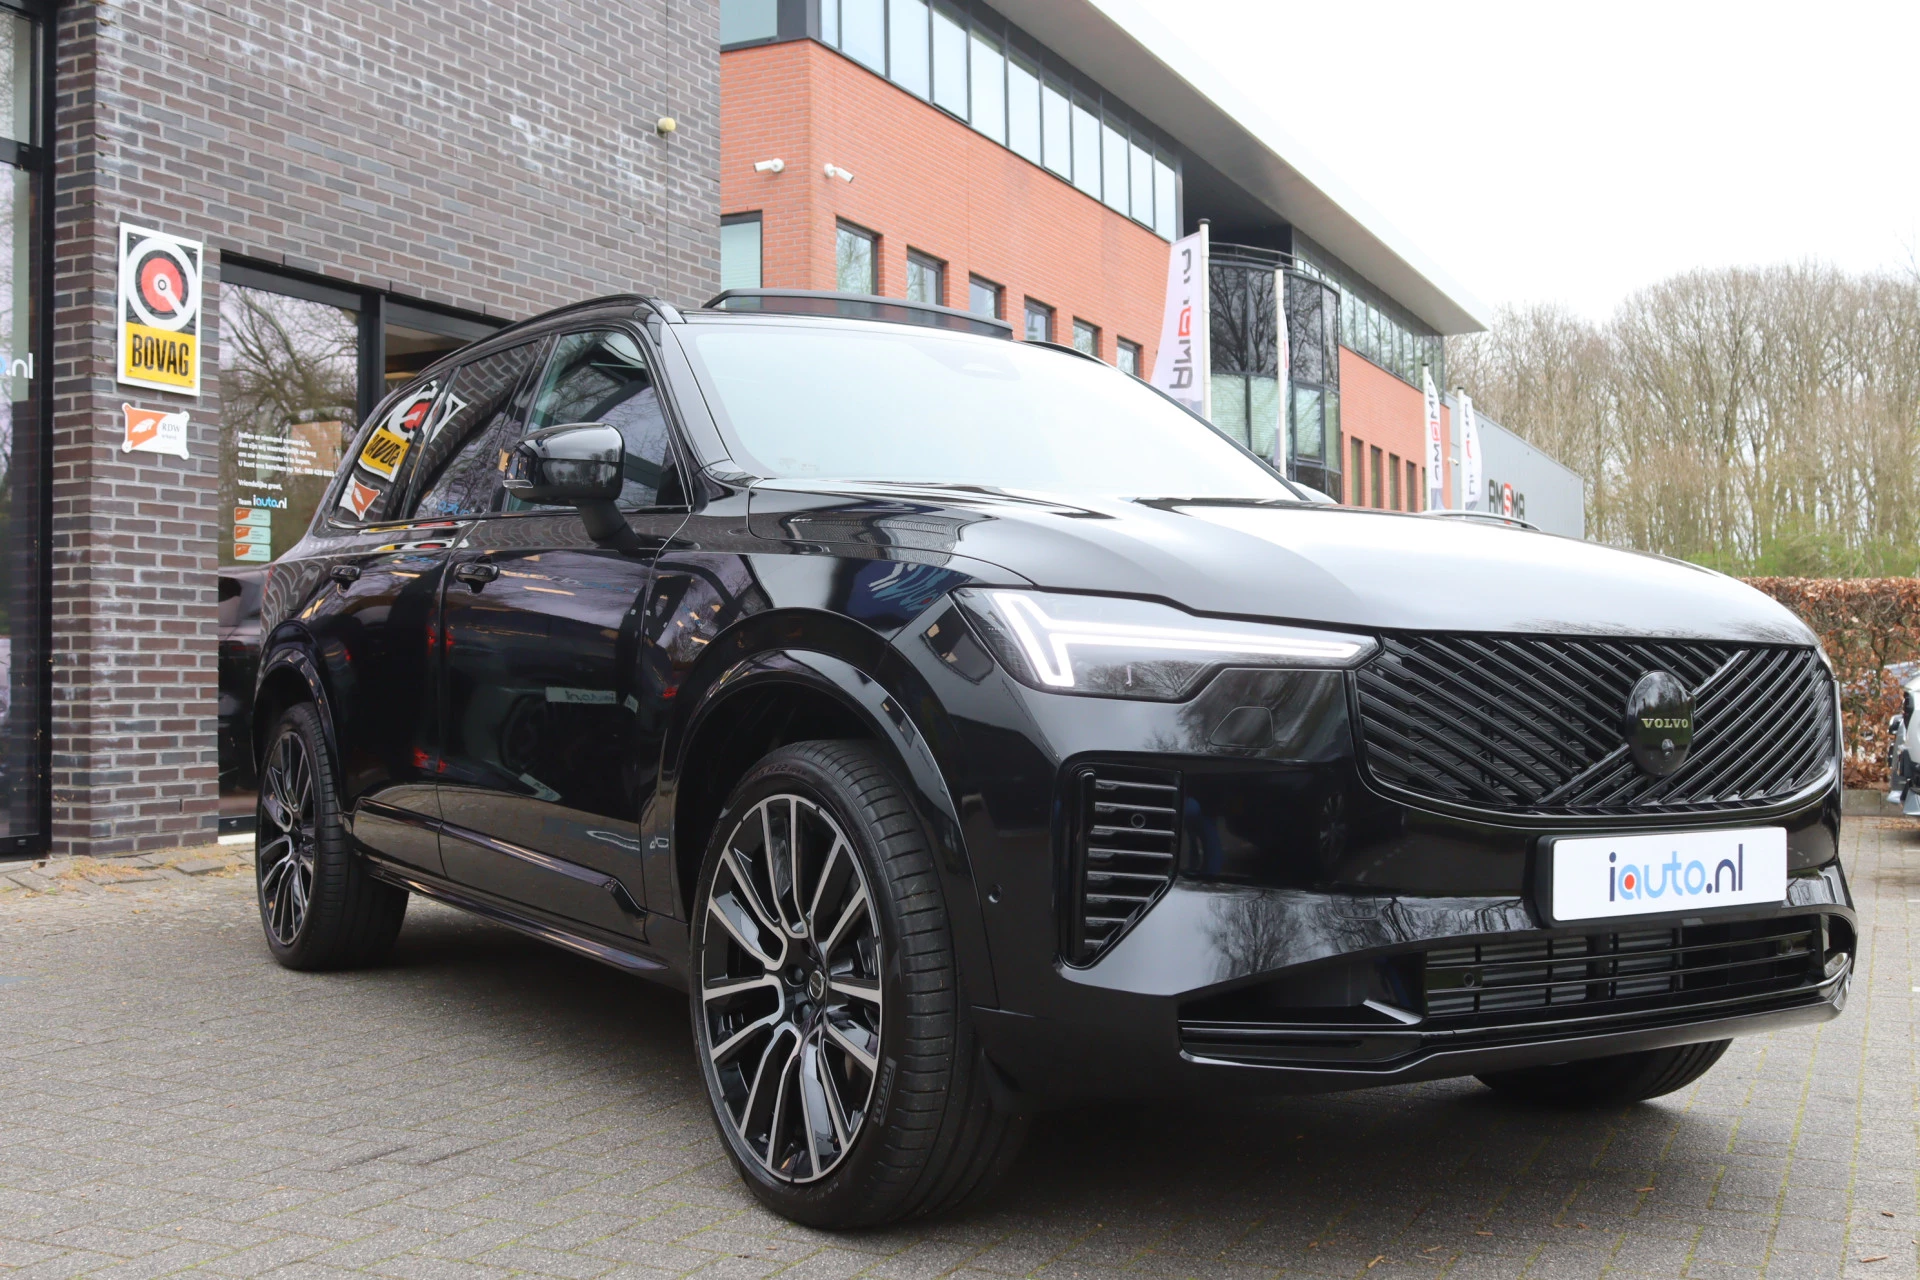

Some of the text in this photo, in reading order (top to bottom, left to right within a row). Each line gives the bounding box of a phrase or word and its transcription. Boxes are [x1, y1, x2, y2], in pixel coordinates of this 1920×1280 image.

[132, 333, 189, 377] BOVAG
[253, 494, 287, 509] iauto.nl
[1641, 718, 1689, 729] VOLVO
[1609, 843, 1743, 902] iauto.nl
